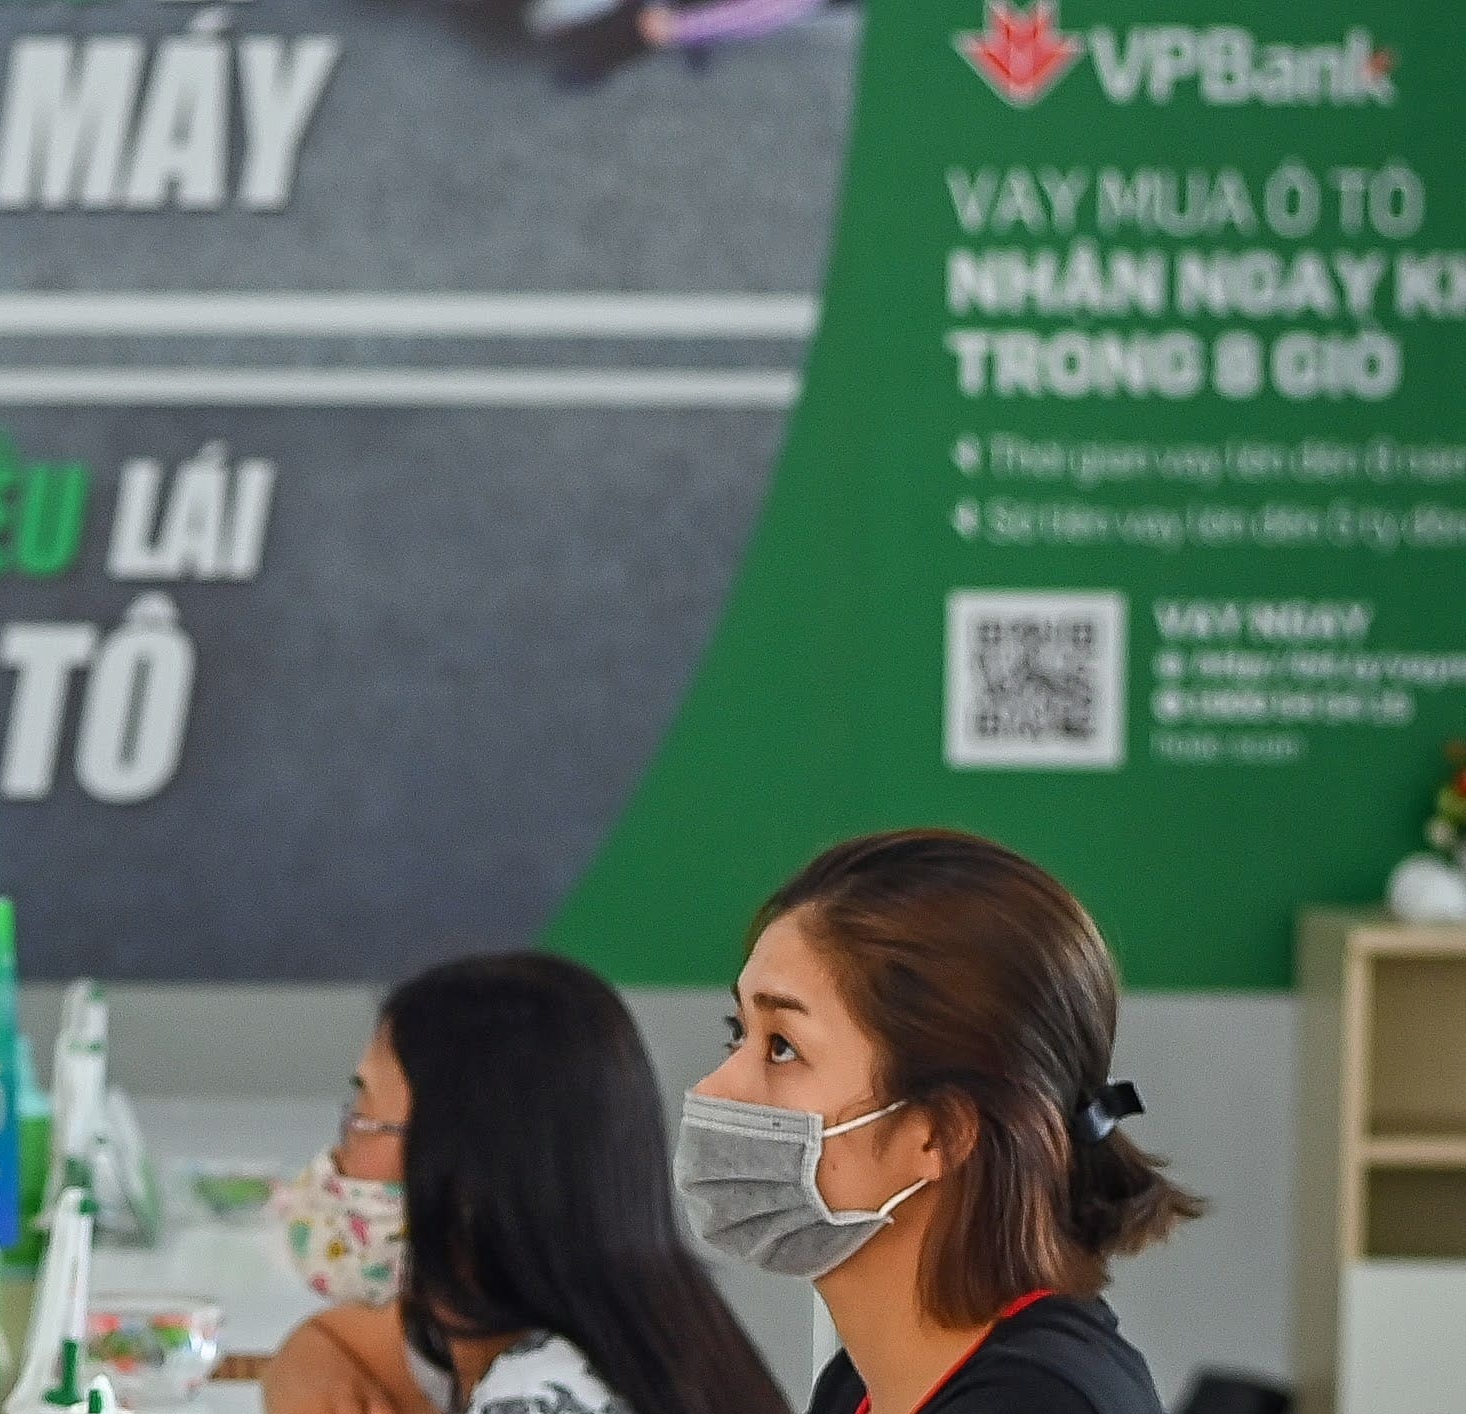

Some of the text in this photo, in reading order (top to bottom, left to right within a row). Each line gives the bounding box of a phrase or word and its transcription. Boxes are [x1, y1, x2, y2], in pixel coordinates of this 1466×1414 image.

[1088, 26, 1398, 103] VPBank
[947, 155, 1427, 238] VAY MUA Ô TÔ
[948, 239, 1165, 322] NHẬN
[1176, 250, 1387, 316] NGAY
[947, 331, 1204, 398] TRONG
[1214, 332, 1263, 398] 8
[107, 438, 276, 580] LÁI
